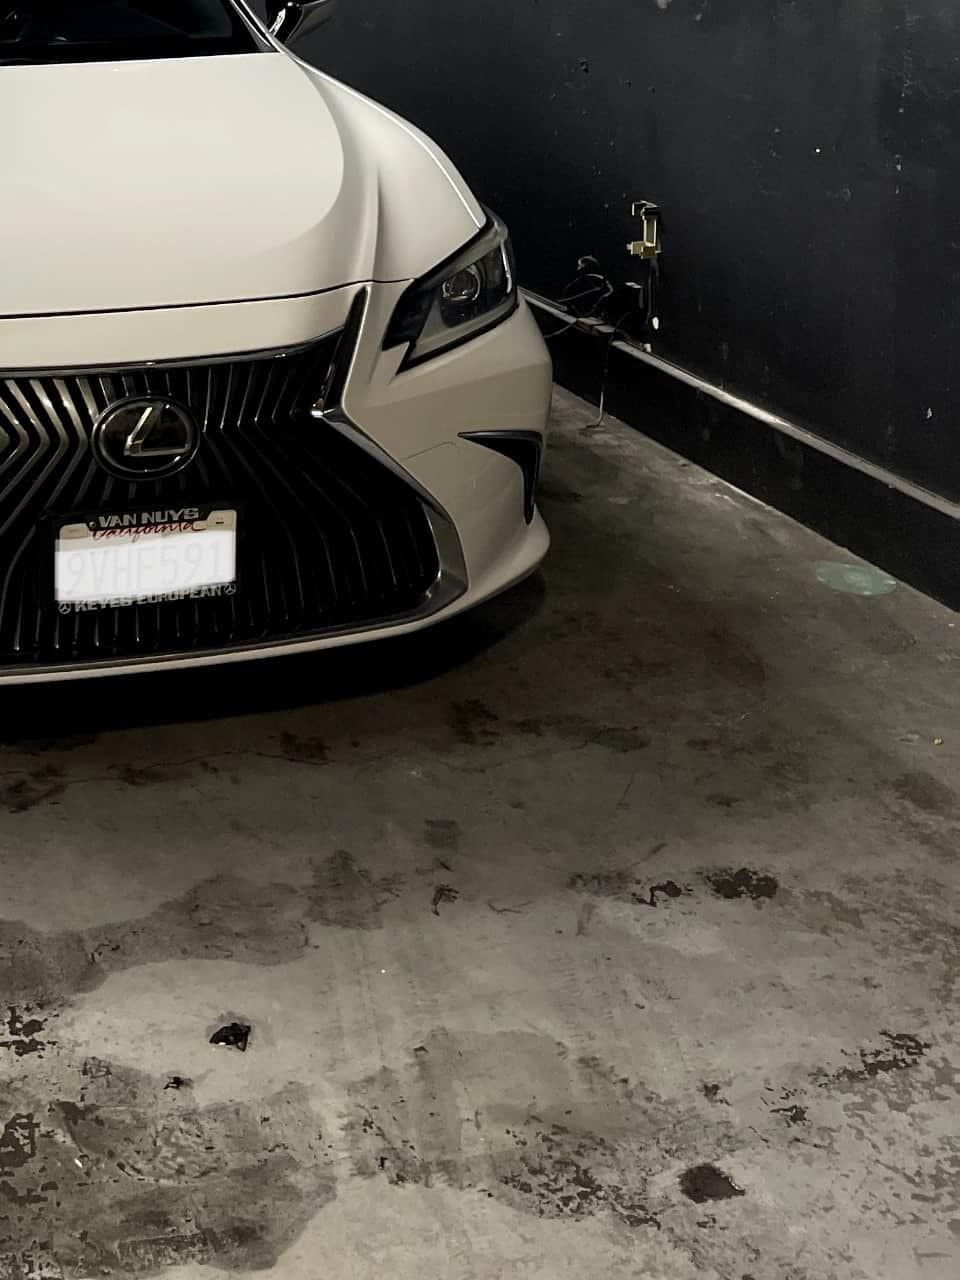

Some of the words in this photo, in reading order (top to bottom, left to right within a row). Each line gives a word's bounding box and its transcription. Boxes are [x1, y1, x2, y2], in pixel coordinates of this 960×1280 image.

[99, 514, 137, 528] VAN
[141, 508, 199, 524] NUYS
[137, 583, 222, 605] EUROPEAN
